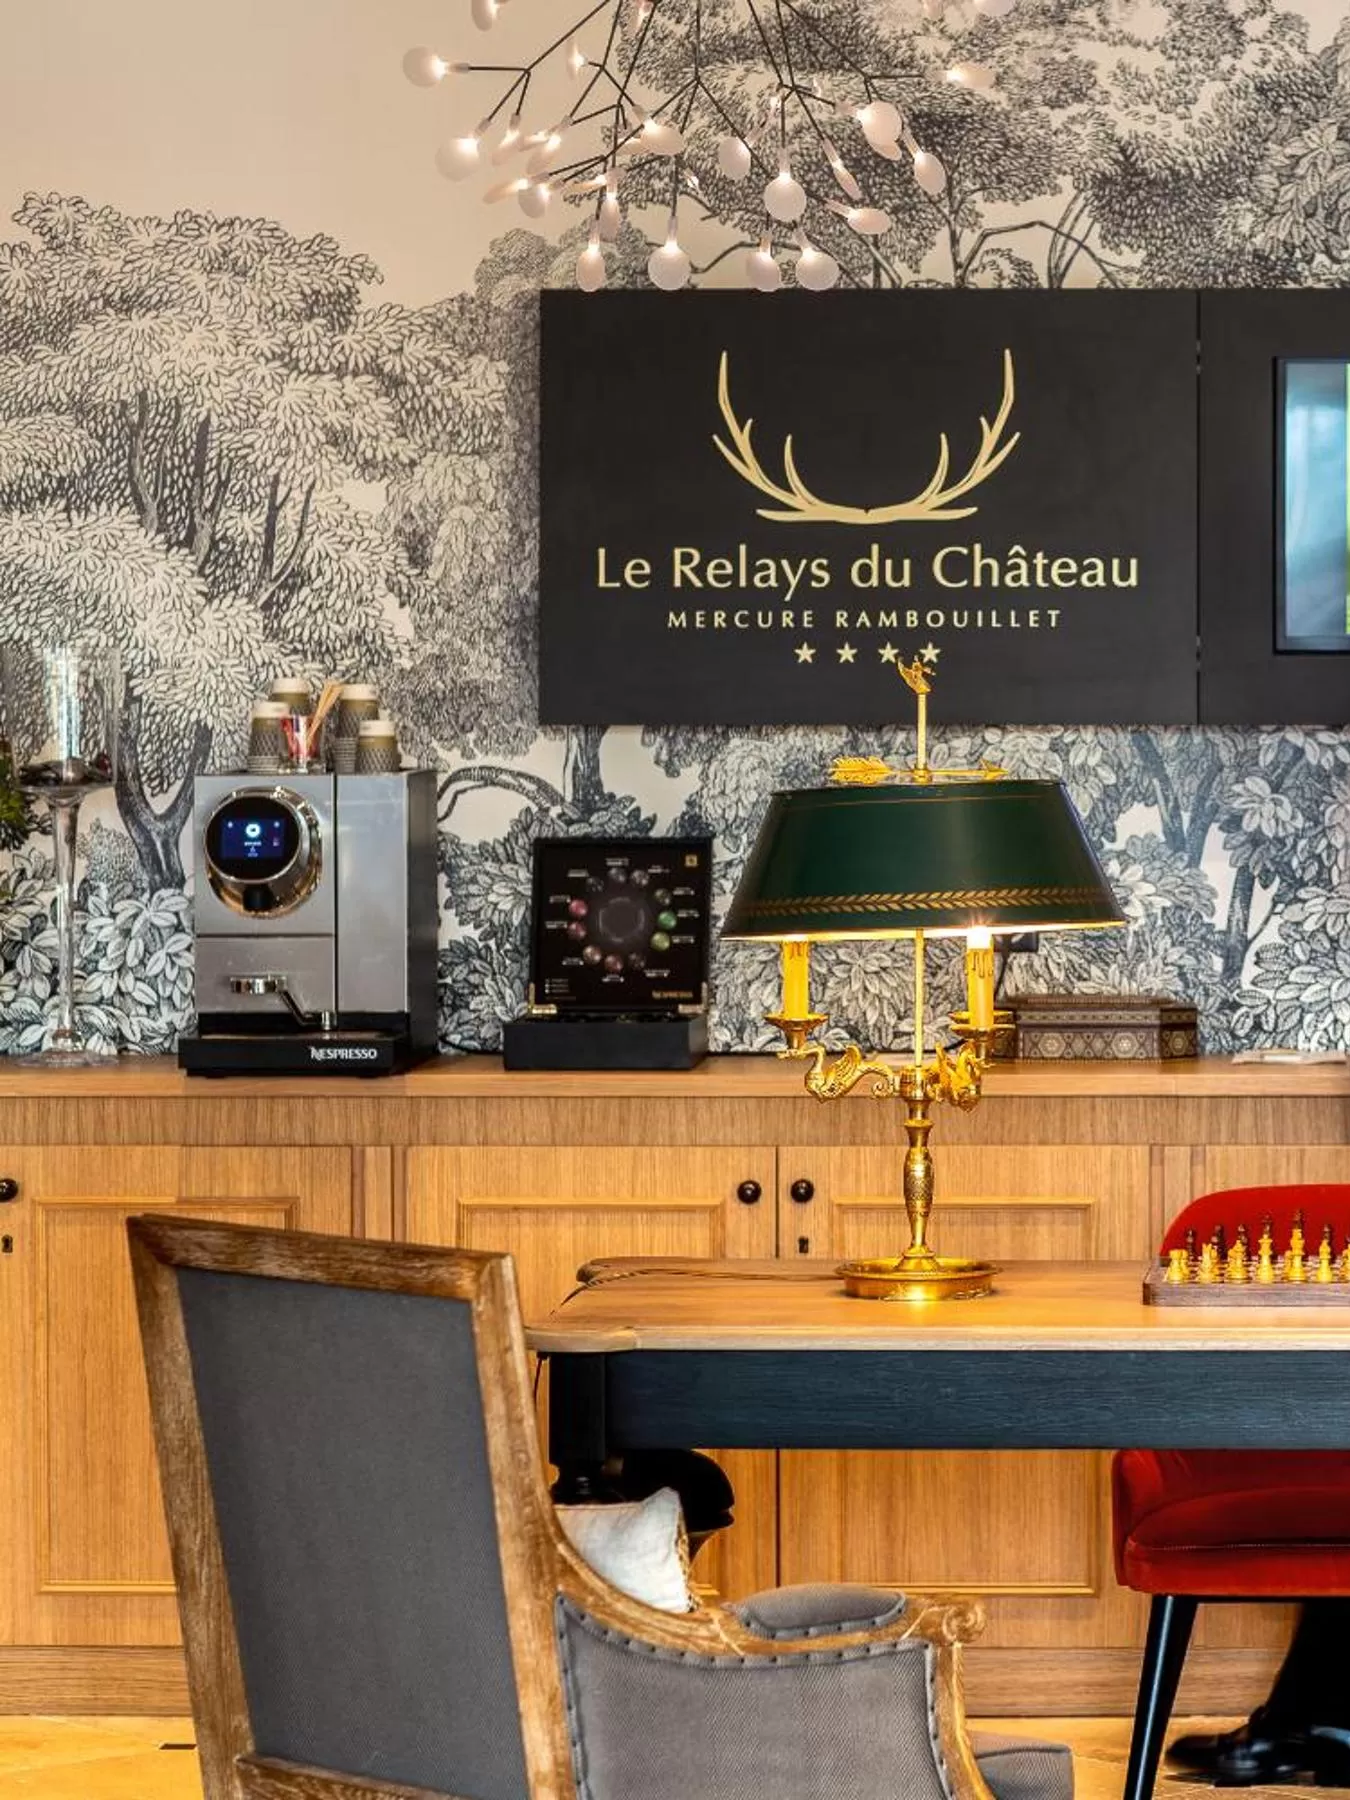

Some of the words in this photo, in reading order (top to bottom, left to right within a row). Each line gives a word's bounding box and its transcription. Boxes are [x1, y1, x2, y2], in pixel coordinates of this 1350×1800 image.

[596, 547, 651, 588] Le
[673, 543, 831, 602] Relays
[850, 543, 911, 588] du
[932, 543, 1139, 588] Château
[667, 610, 814, 629] MERCURE
[835, 610, 1061, 628] RAMBOUILLET
[310, 1046, 377, 1060] NESPRESSO
